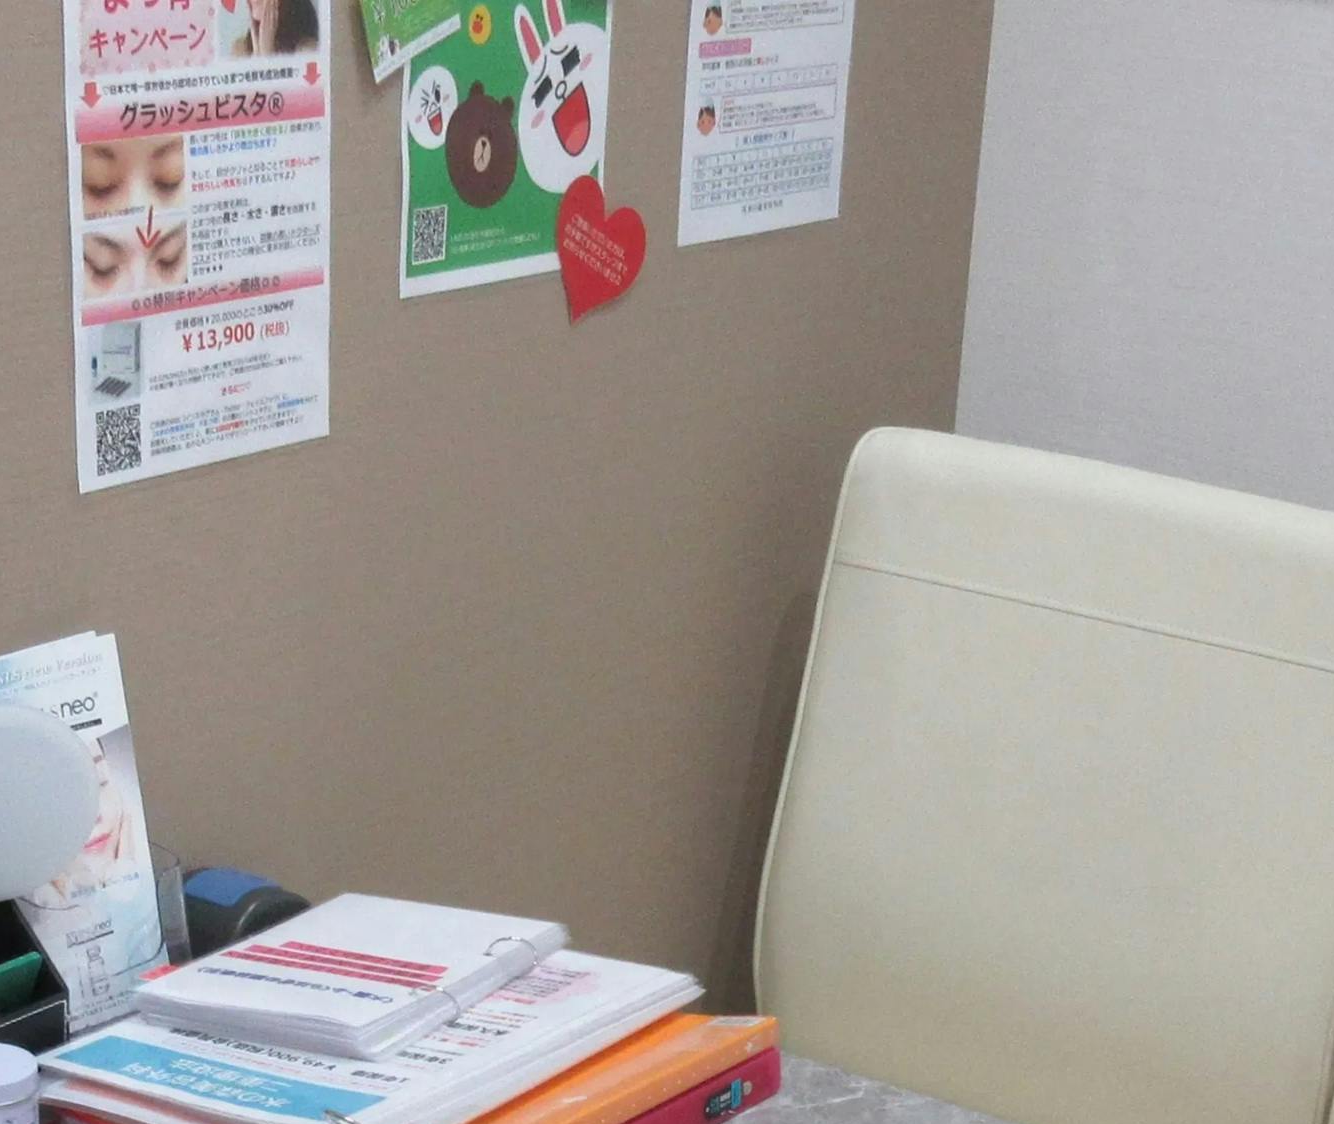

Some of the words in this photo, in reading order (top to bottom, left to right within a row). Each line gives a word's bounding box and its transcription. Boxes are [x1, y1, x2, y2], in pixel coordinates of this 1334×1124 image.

[89, 24, 206, 58] キャンペーン
